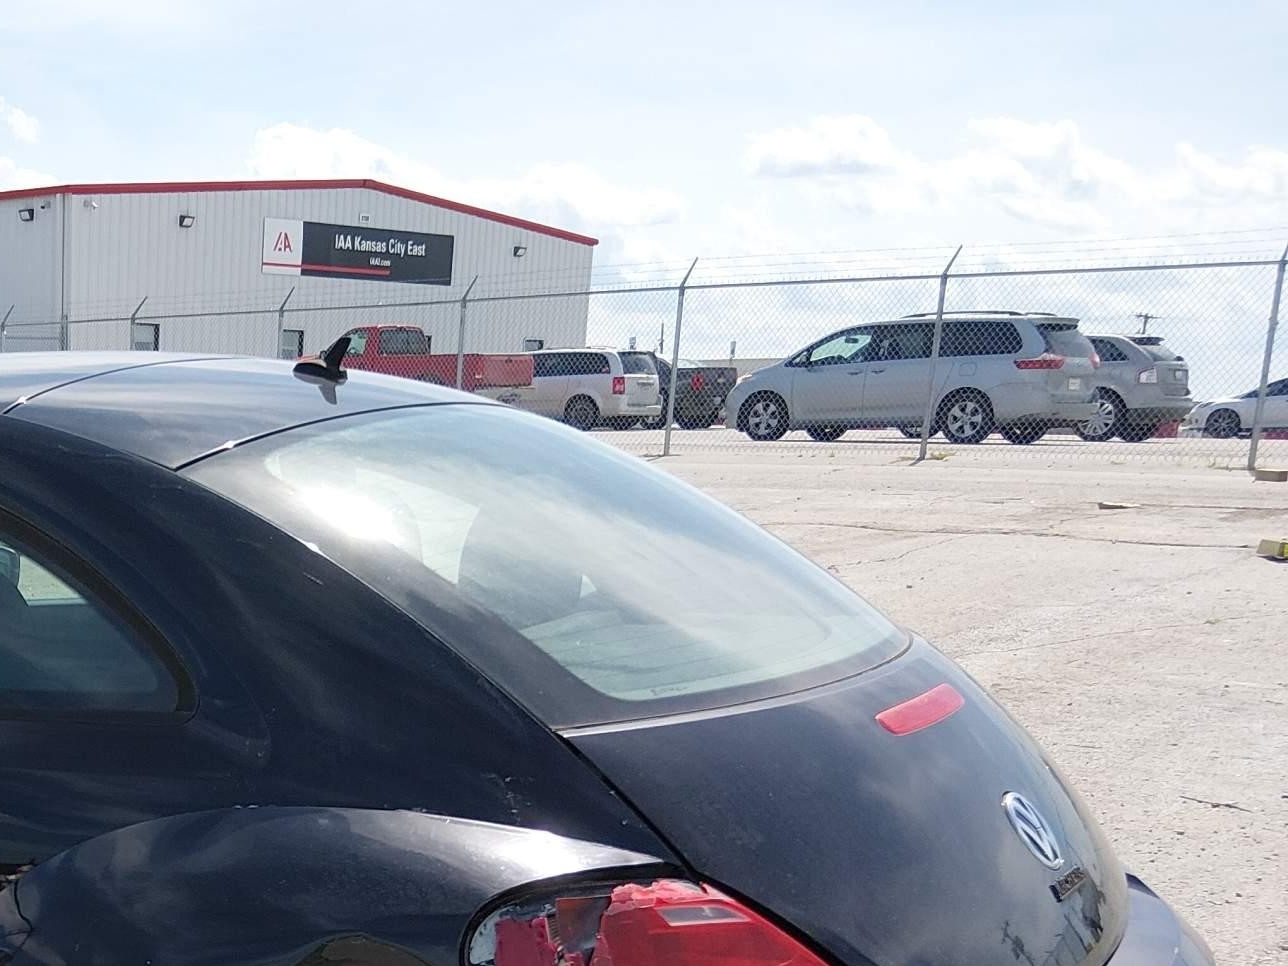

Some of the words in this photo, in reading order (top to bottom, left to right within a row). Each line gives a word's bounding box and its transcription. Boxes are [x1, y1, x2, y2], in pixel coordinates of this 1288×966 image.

[335, 233, 352, 250] IAA
[354, 235, 387, 253] Kansas
[388, 238, 406, 258] City
[407, 240, 426, 256] East
